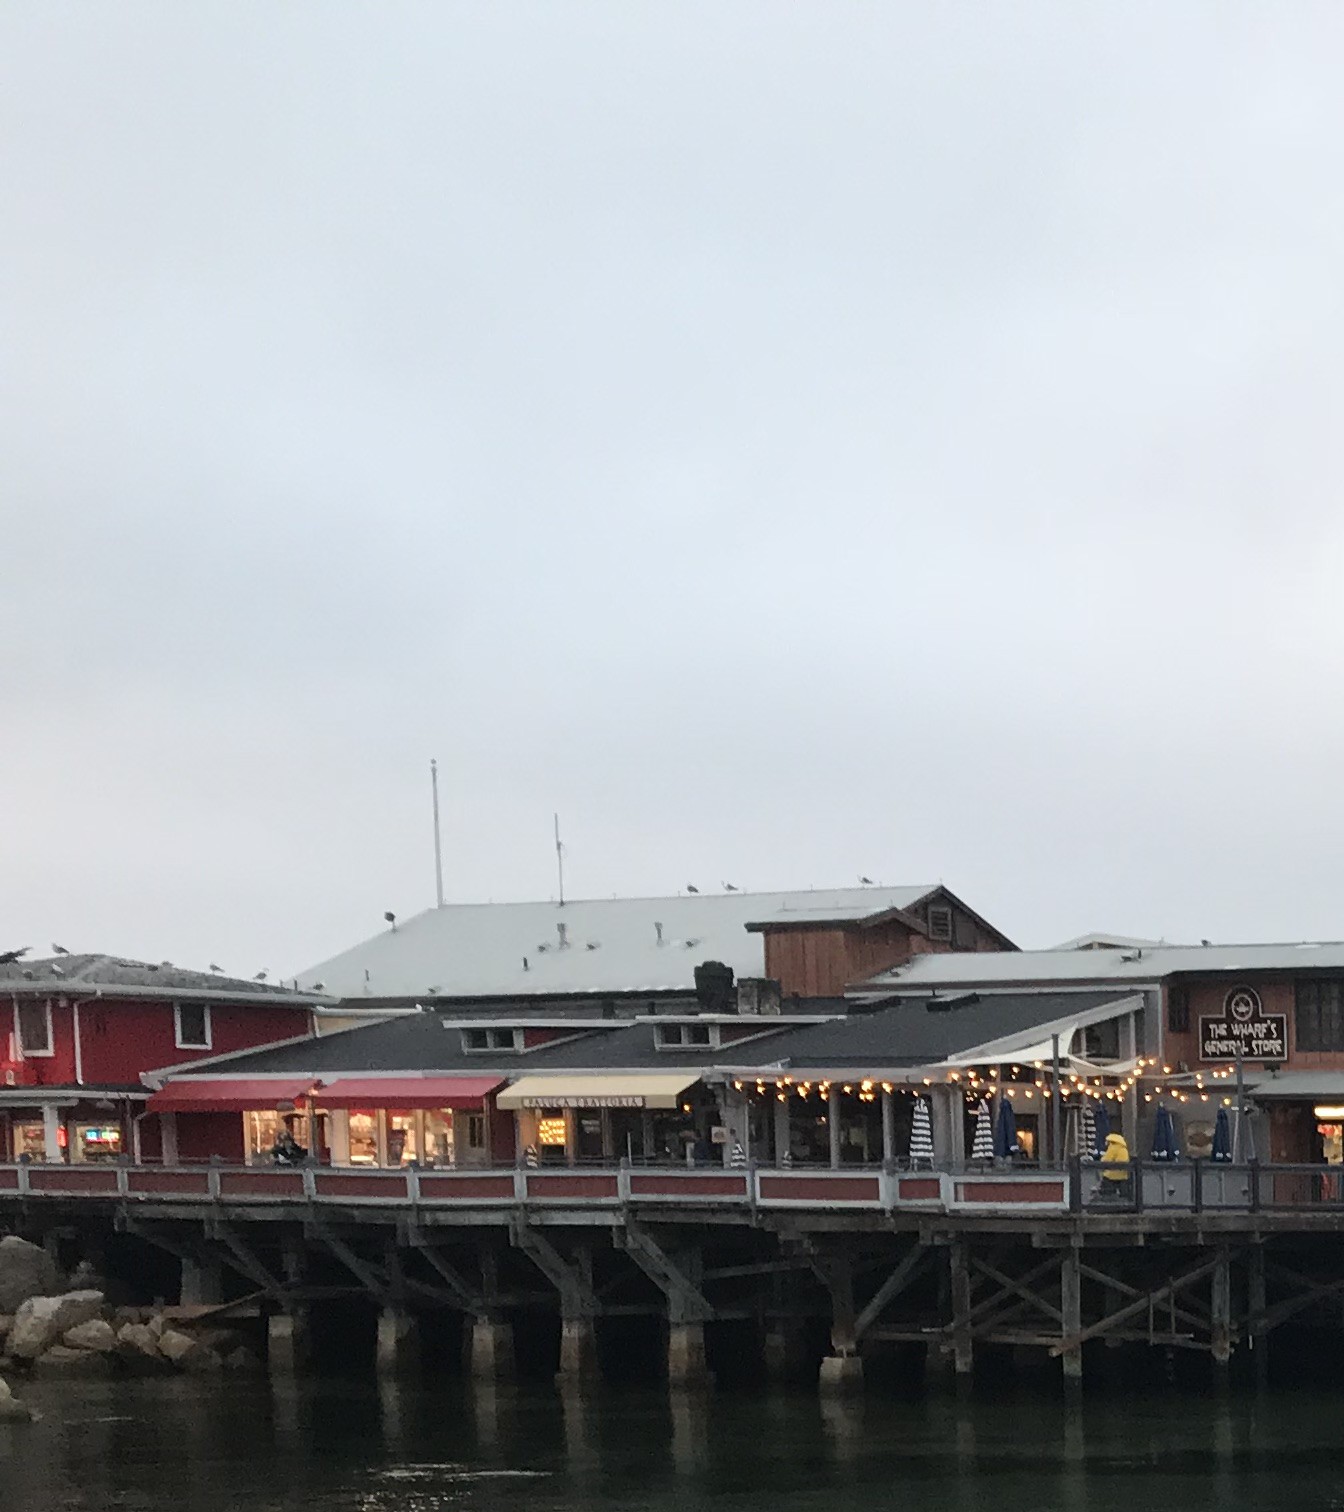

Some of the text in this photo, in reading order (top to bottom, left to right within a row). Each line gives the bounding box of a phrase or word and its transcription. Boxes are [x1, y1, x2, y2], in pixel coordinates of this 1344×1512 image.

[1209, 1020, 1277, 1039] THE WHARF'S
[1252, 1040, 1282, 1056] STORE
